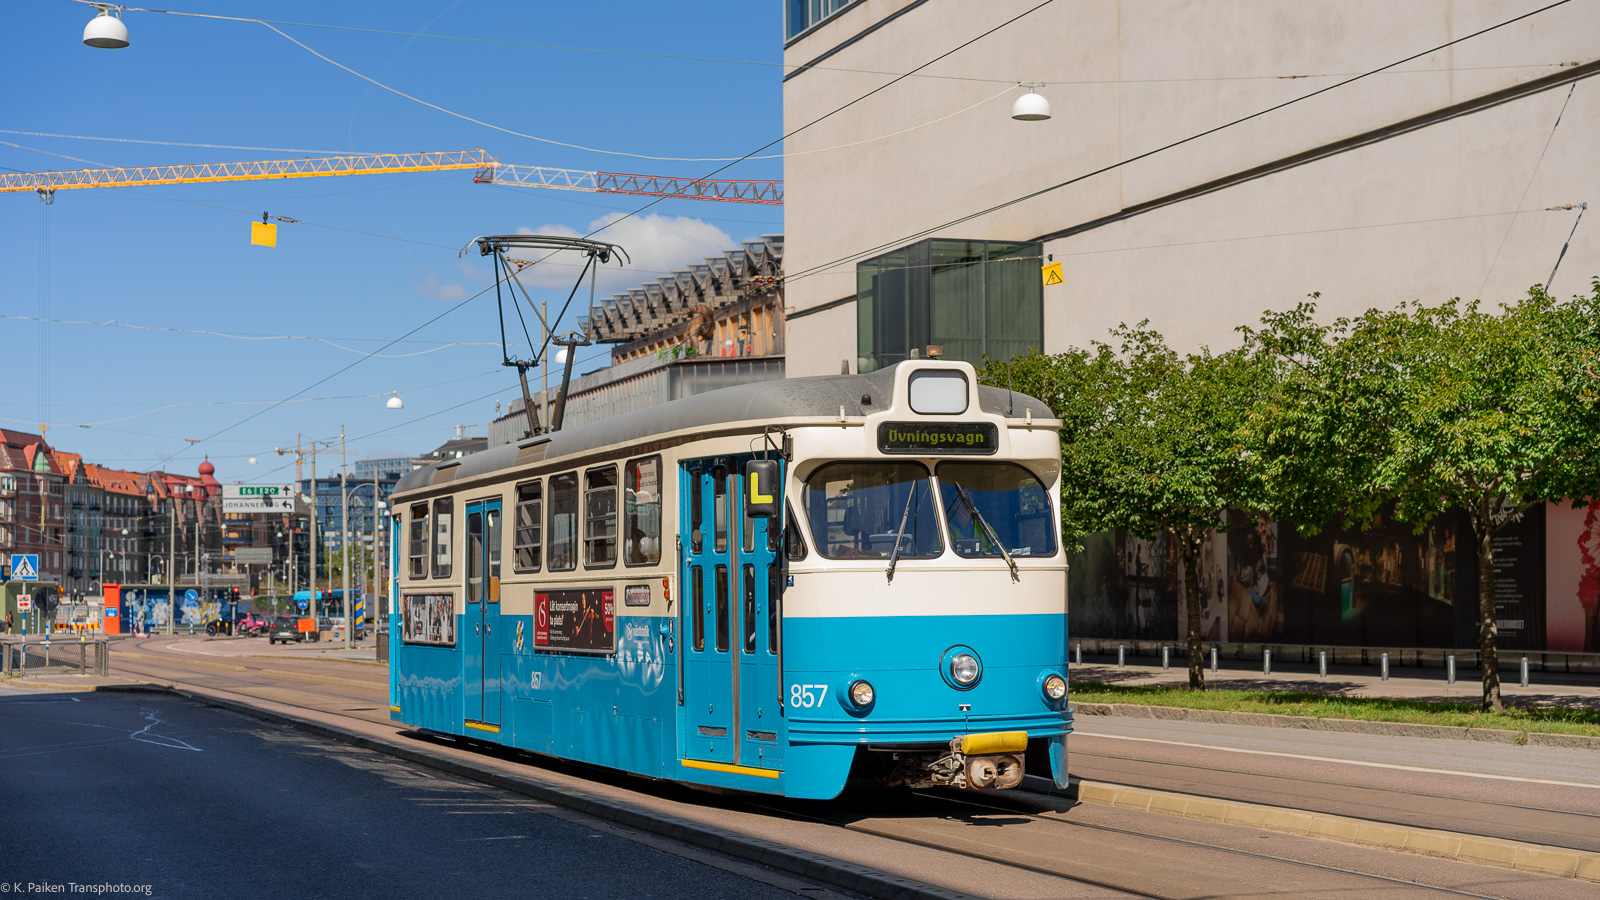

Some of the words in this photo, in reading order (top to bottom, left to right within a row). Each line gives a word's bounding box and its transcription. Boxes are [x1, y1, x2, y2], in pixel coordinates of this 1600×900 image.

[888, 429, 984, 445] Övningsvagn
[750, 472, 774, 504] L
[531, 671, 542, 689] 857
[790, 683, 829, 708] 857
